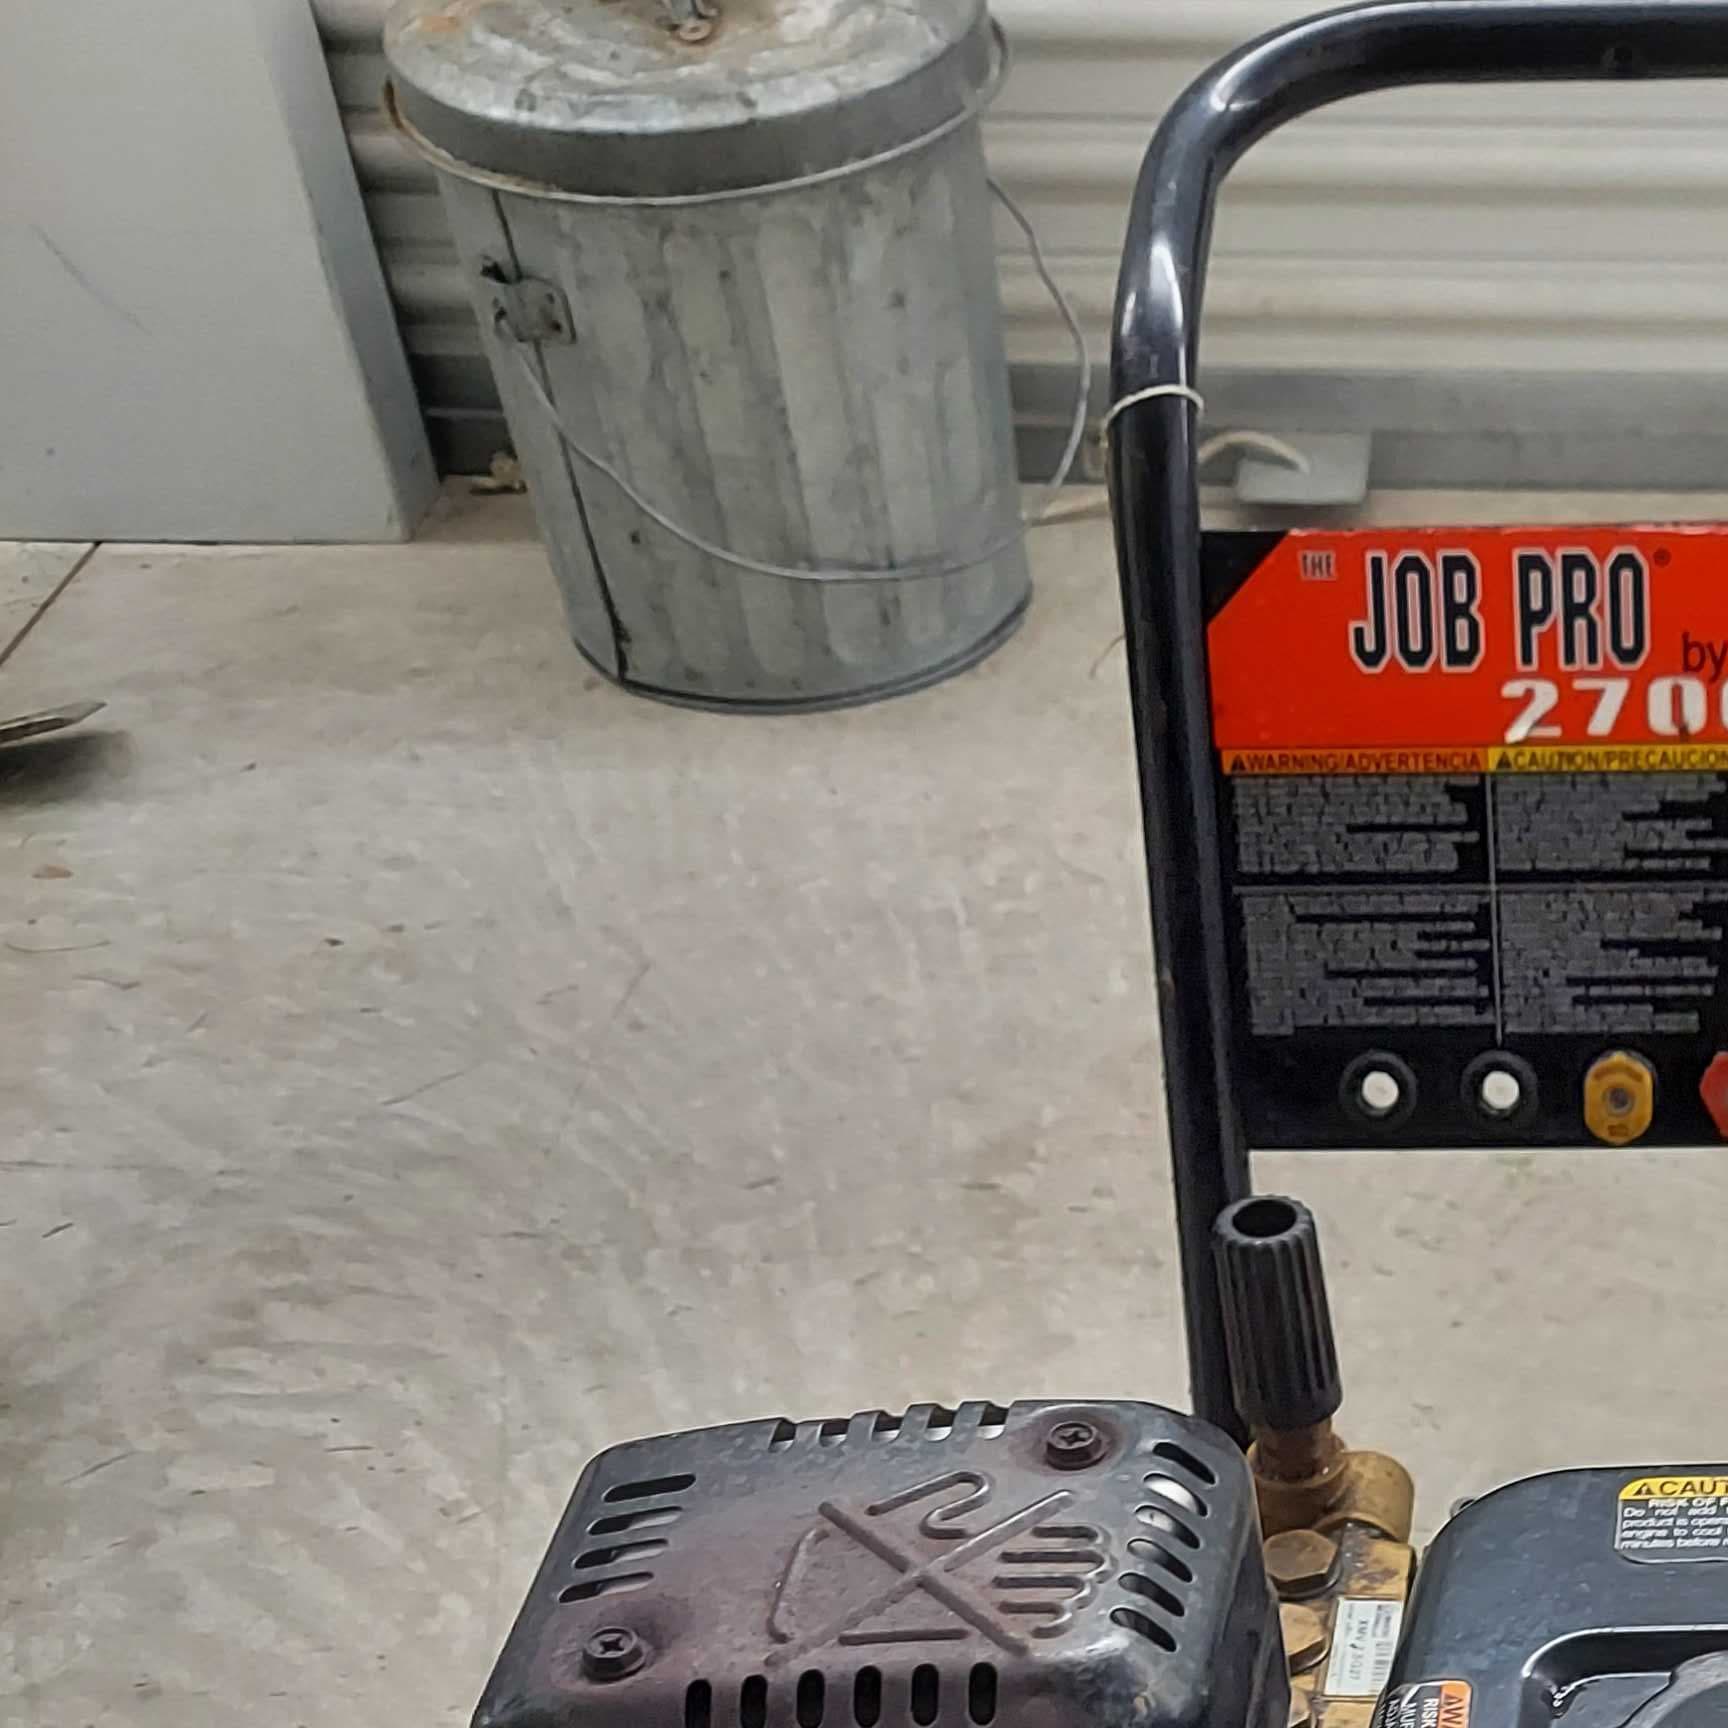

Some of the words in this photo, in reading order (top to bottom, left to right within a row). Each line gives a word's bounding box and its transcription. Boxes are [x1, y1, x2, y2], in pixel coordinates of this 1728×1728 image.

[1302, 553, 1337, 579] THE
[1350, 550, 1485, 673] JOB
[1512, 547, 1650, 671] PRO
[1682, 631, 1728, 682] by
[1623, 1507, 1645, 1517] Do
[1420, 1698, 1439, 1728] RISK
